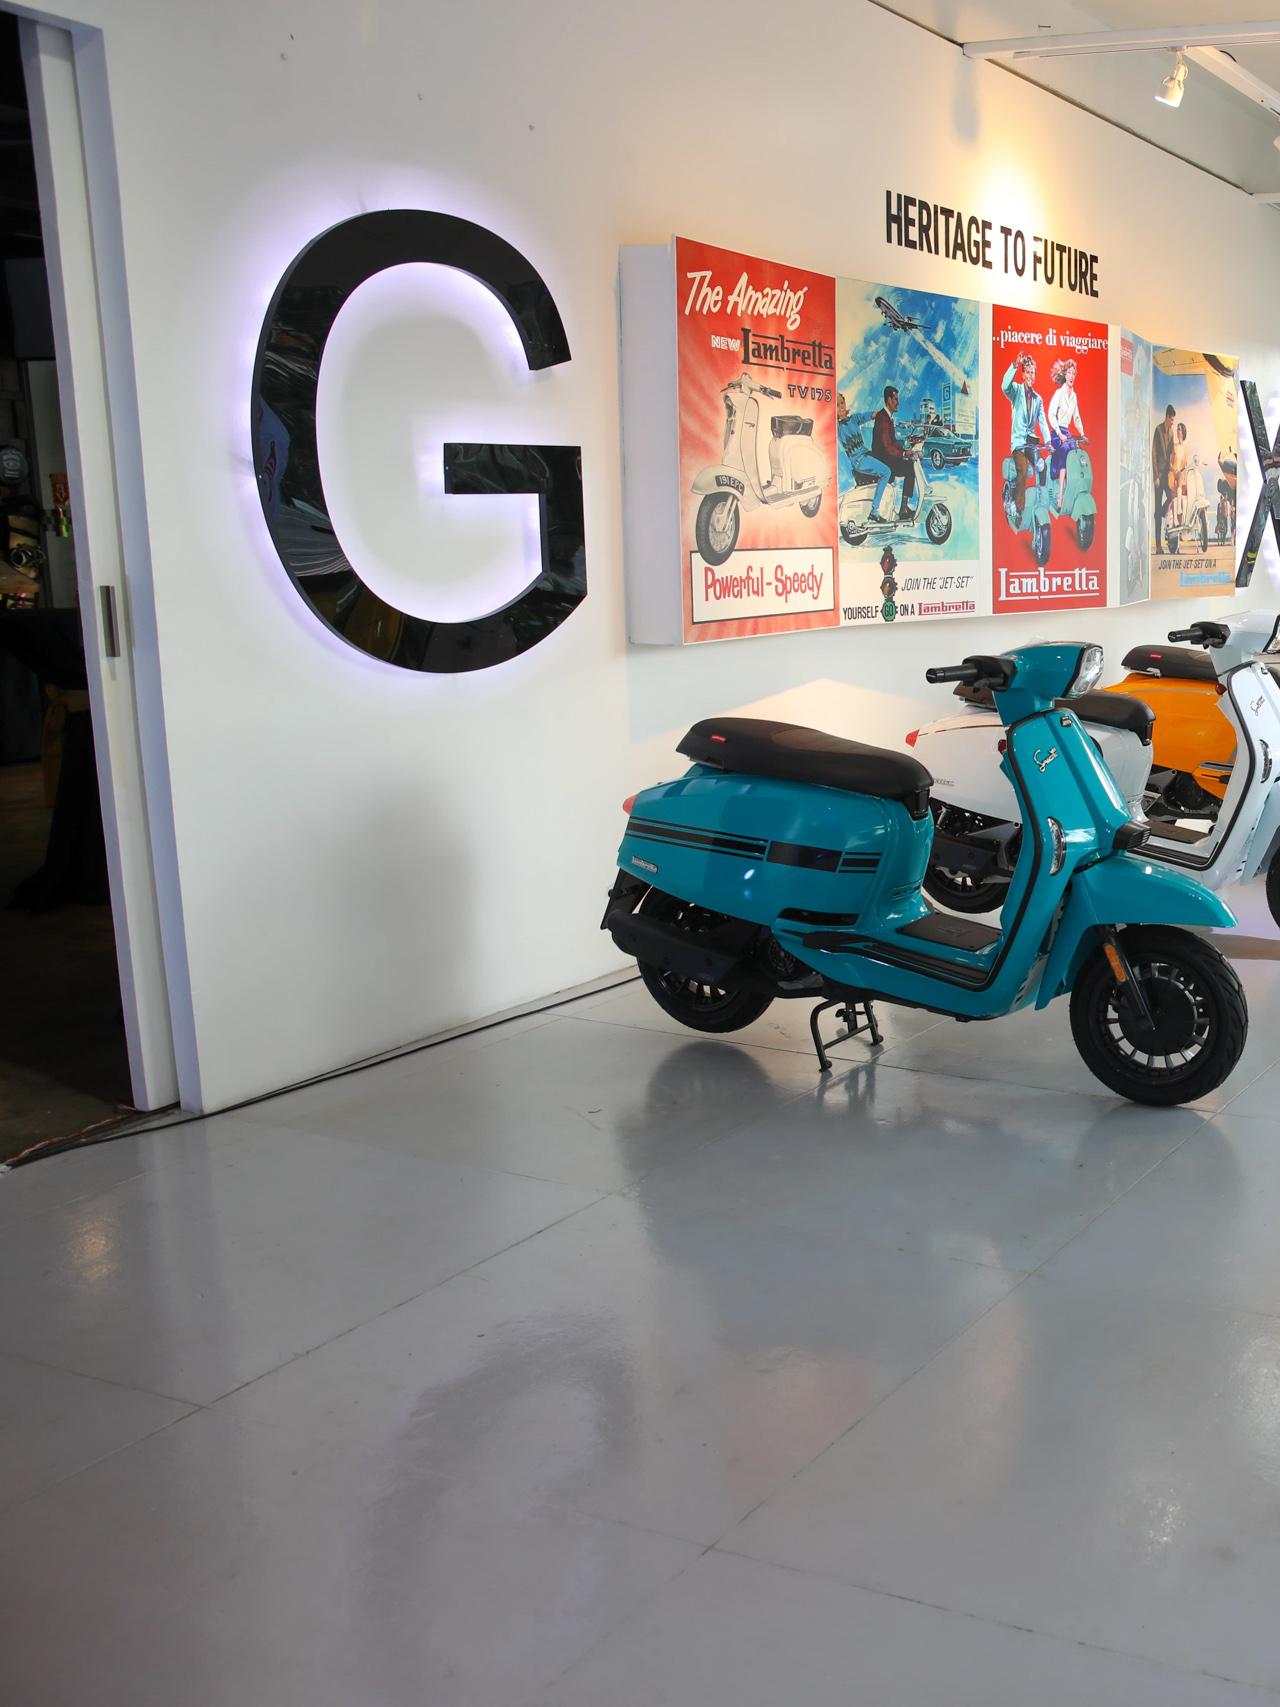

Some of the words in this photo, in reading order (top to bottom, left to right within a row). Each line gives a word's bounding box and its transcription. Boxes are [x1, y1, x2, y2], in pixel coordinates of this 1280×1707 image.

[885, 189, 993, 270] HERITAGE
[1000, 225, 1026, 277] TO
[1033, 235, 1099, 299] FUTURE
[684, 270, 723, 316] The
[726, 271, 809, 331] Amazing
[711, 334, 741, 352] NEW
[741, 327, 834, 377] Lambretta
[1045, 328, 1057, 346] di
[1060, 331, 1108, 354] viaggiare
[250, 208, 588, 674] G
[901, 578, 922, 592] JOIN
[922, 577, 937, 590] THE
[998, 567, 1100, 601] Lambretta
[843, 605, 880, 621] YOURSELF
[884, 605, 894, 617] GO
[899, 603, 909, 617] ON
[910, 603, 915, 616] A
[918, 600, 975, 616] Lambretta
